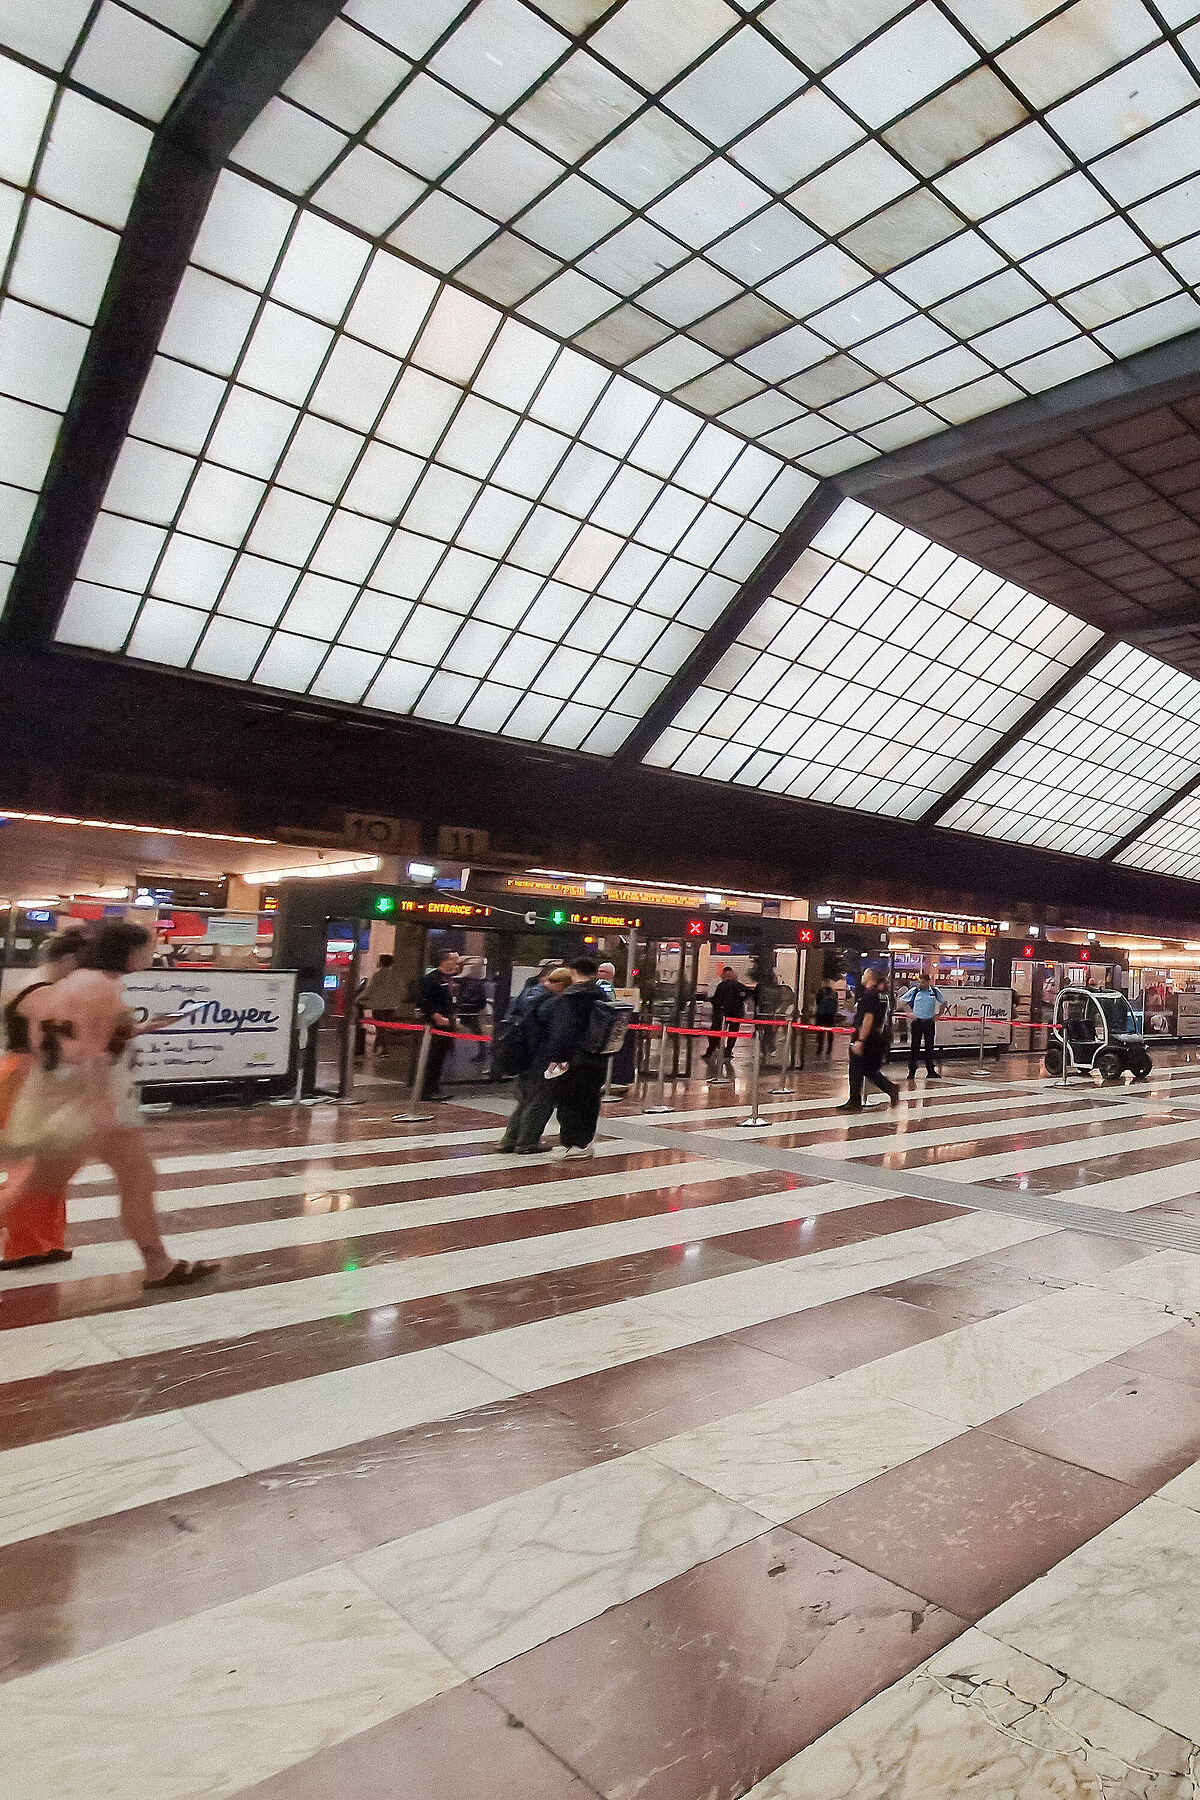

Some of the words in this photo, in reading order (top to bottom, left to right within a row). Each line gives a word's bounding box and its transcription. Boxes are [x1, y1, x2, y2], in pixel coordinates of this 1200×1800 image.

[428, 903, 473, 915] ENTRANCE
[591, 916, 625, 926] ENTRANCE
[178, 999, 279, 1035] Meyer
